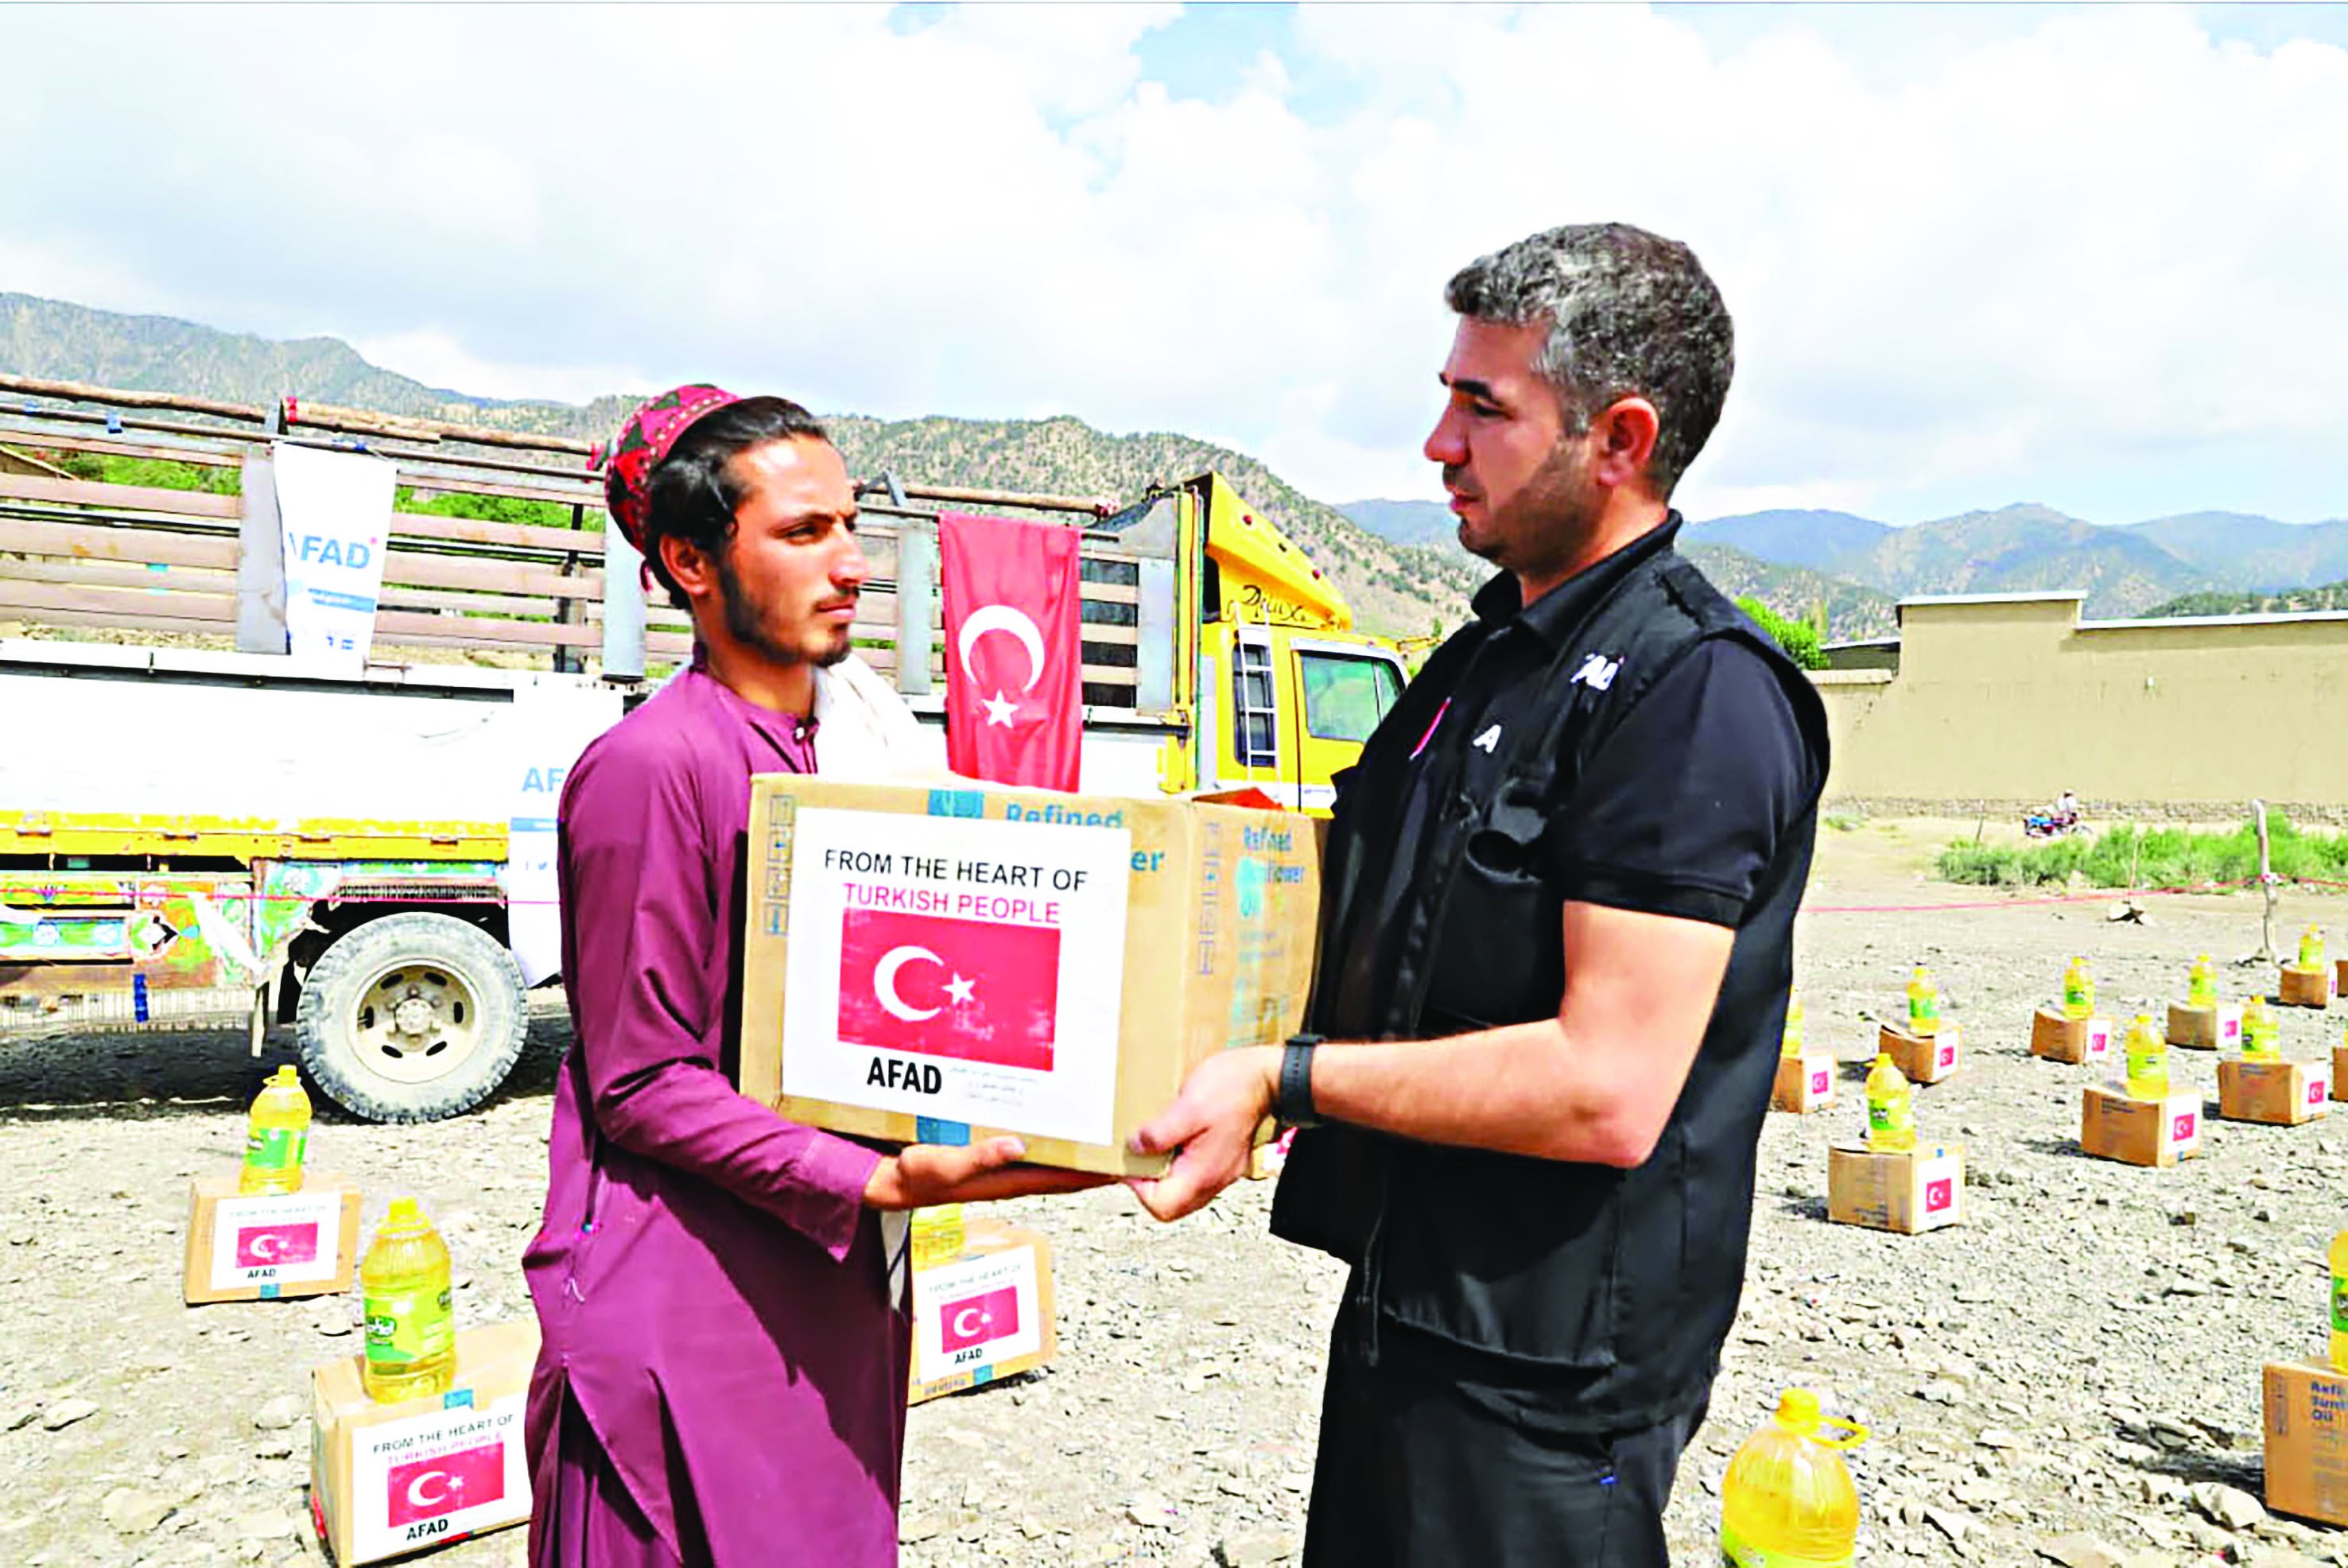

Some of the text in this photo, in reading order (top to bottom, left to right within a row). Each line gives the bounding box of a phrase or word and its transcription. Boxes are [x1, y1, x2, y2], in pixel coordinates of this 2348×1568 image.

[1006, 801, 1124, 829] Refined
[825, 848, 1089, 892] FROM THE HEART OF
[1130, 849, 1165, 871] er
[843, 882, 1061, 925] TURKISH PEOPLE
[867, 1056, 942, 1095] AFAD
[246, 1268, 277, 1279] AFAD
[954, 1347, 983, 1365] AFAD
[373, 1414, 514, 1454] FROM THE HEART OF
[406, 1518, 449, 1542] AFAD
